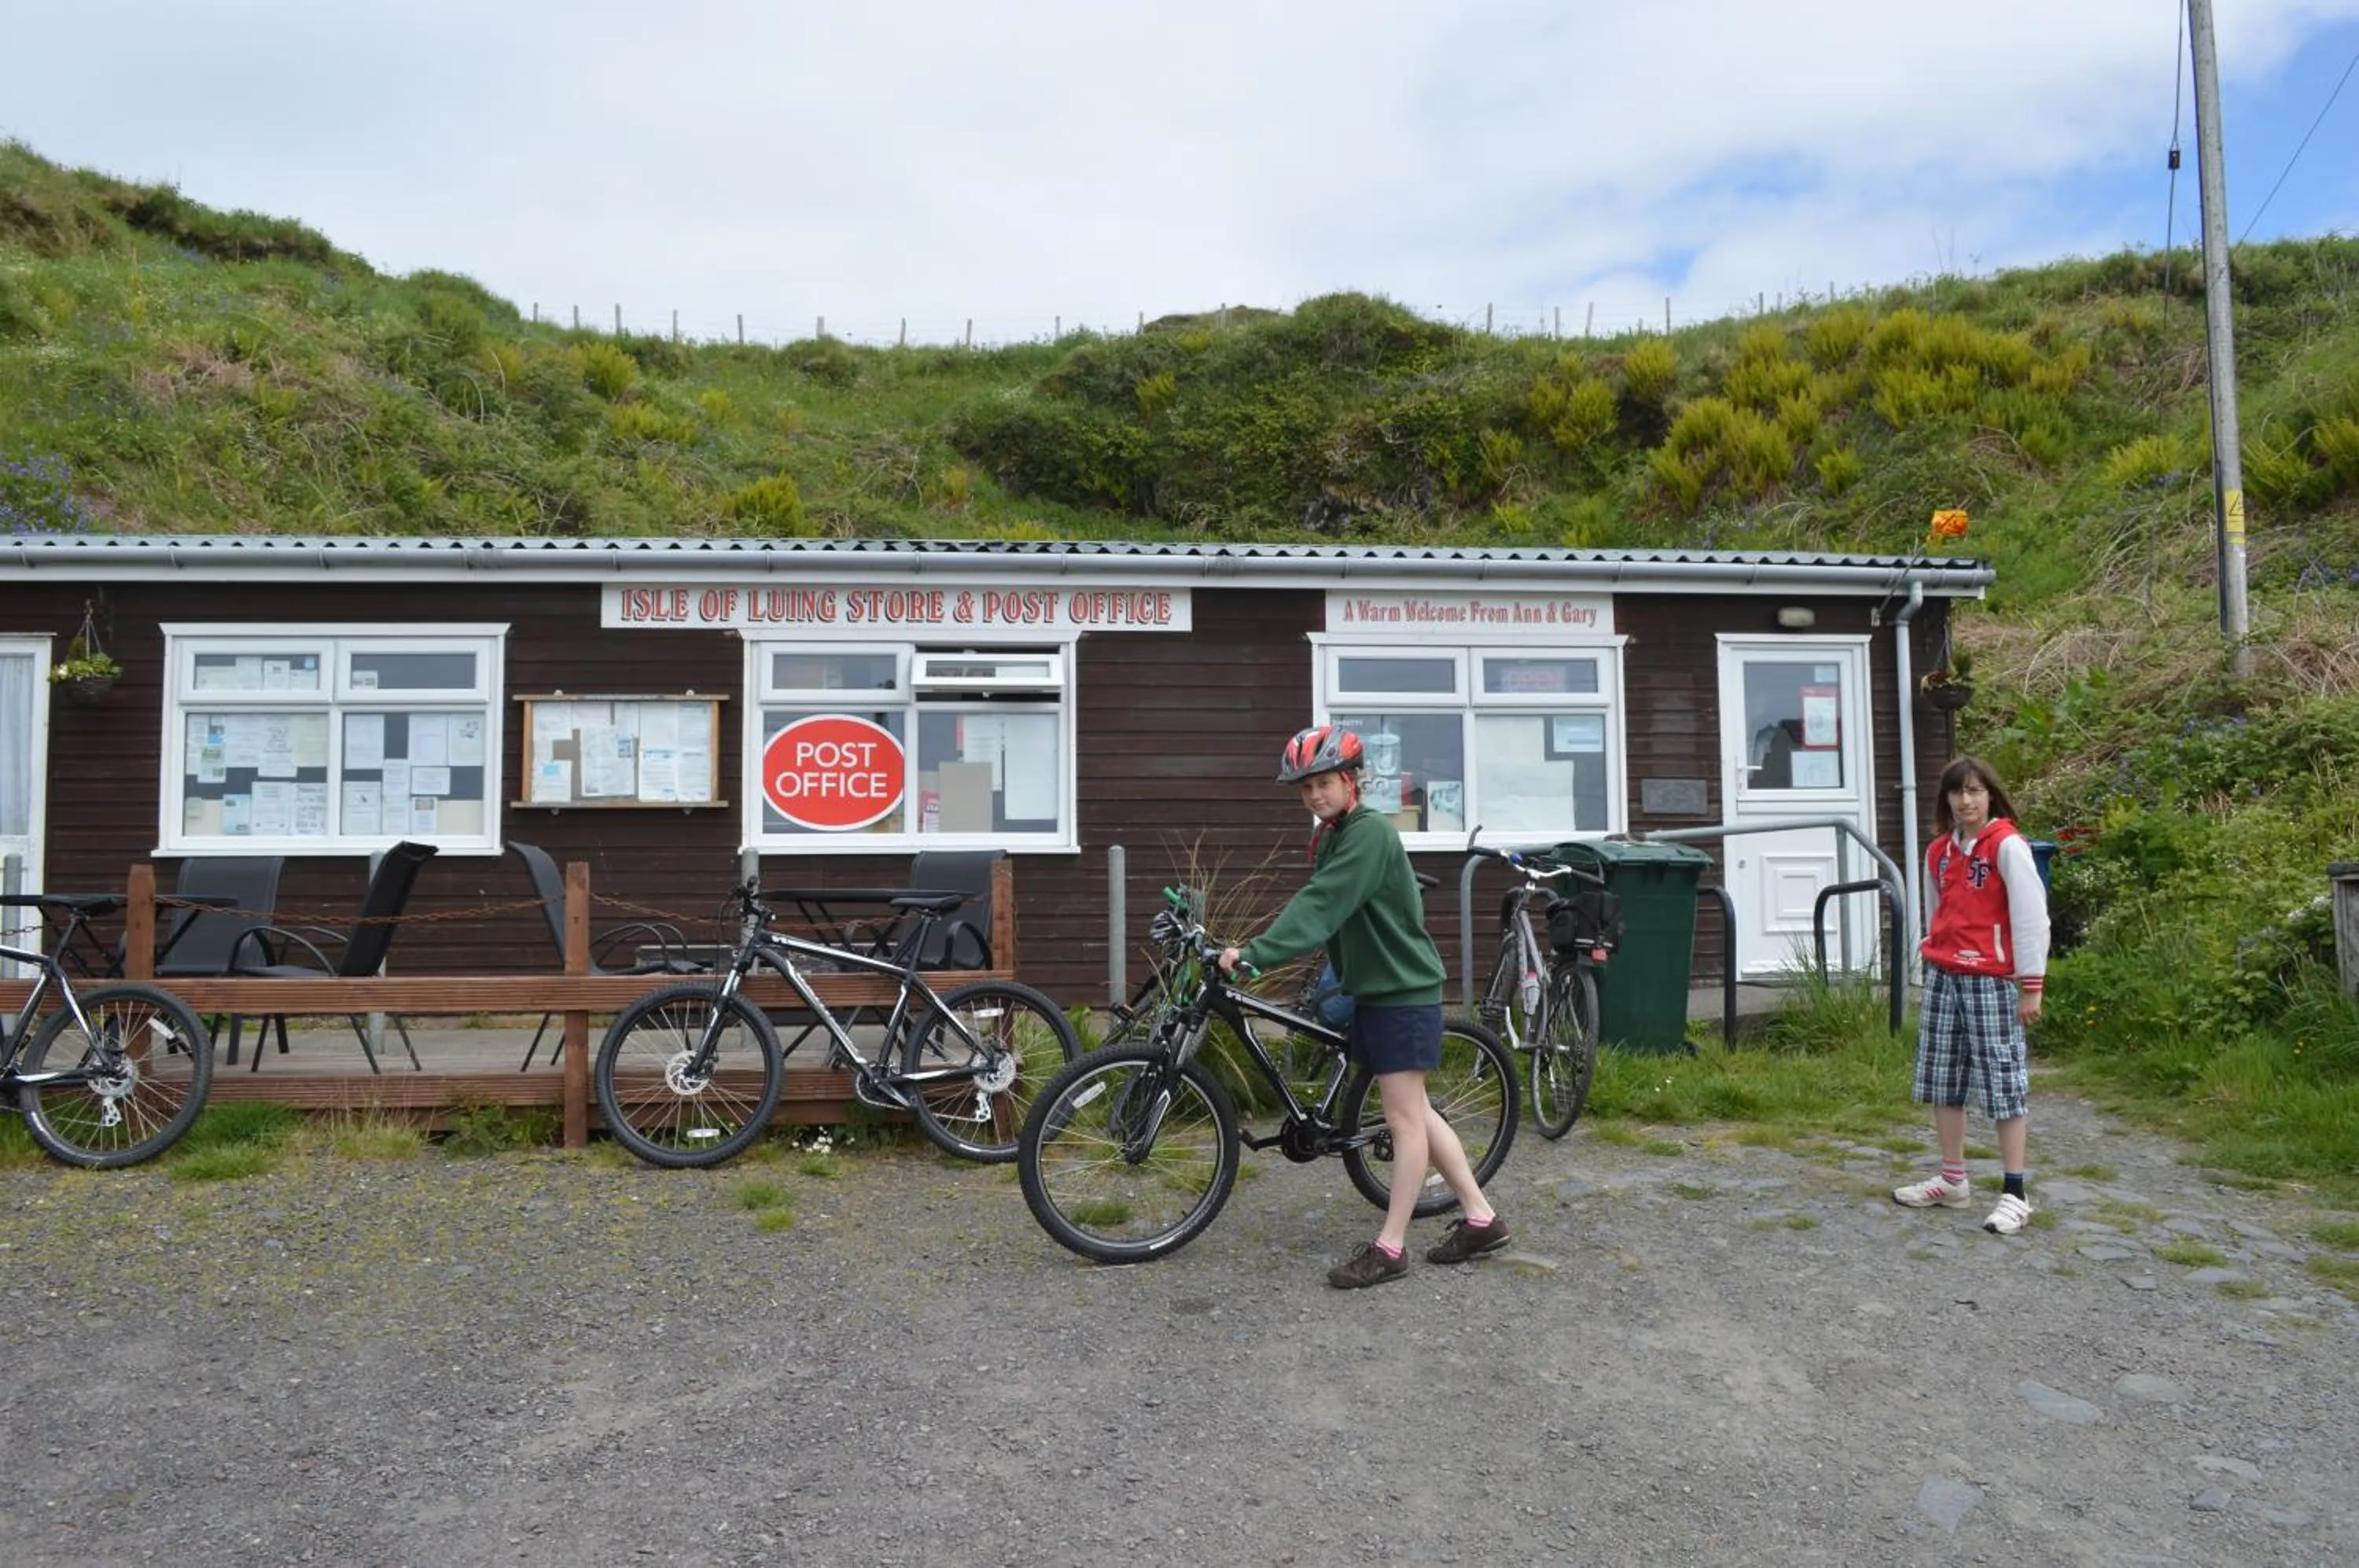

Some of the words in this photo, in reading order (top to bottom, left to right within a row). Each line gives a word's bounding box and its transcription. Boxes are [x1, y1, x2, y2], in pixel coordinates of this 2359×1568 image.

[621, 588, 690, 621] ISLE
[699, 588, 738, 621] OF
[748, 589, 837, 622] LUING
[845, 590, 944, 623] STORE
[953, 591, 974, 623] &
[983, 591, 1059, 624] POST
[1069, 591, 1172, 625] OFFICE
[1342, 599, 1354, 622] A
[1356, 599, 1401, 623] Warm
[1404, 600, 1467, 623] Welcome
[1470, 600, 1509, 623] From
[1513, 602, 1542, 624] Ann
[1545, 602, 1558, 624] &
[1561, 602, 1597, 628] Gary
[796, 742, 878, 768] POST
[775, 771, 889, 798] OFFICE
